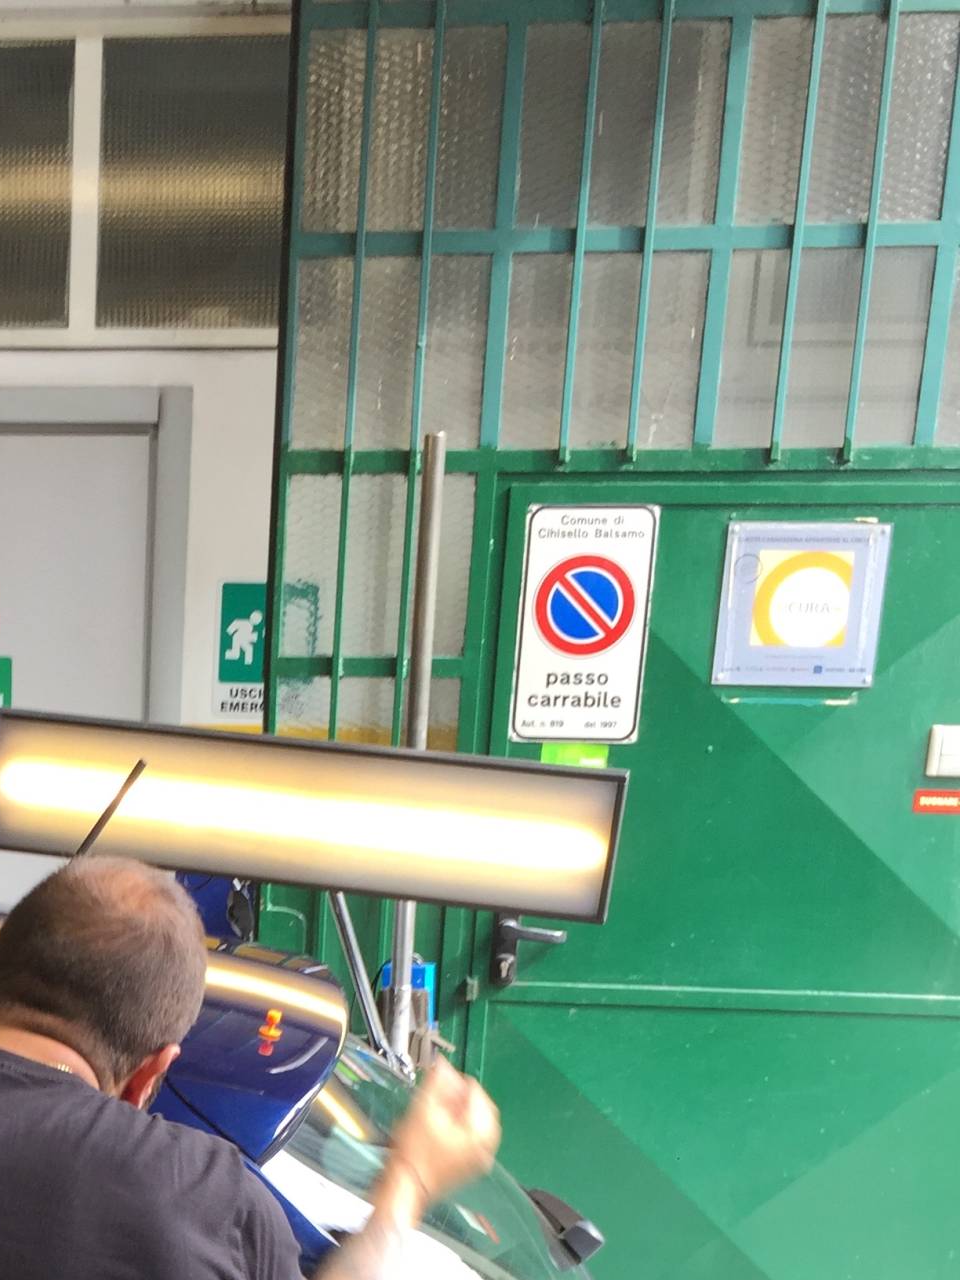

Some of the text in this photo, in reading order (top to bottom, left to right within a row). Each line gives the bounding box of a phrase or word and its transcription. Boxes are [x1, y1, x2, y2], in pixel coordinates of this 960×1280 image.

[560, 513, 625, 526] Comune di
[594, 528, 646, 539] Balsamo
[546, 671, 609, 688] passo
[229, 687, 264, 699] USCI
[527, 691, 622, 708] carrabile
